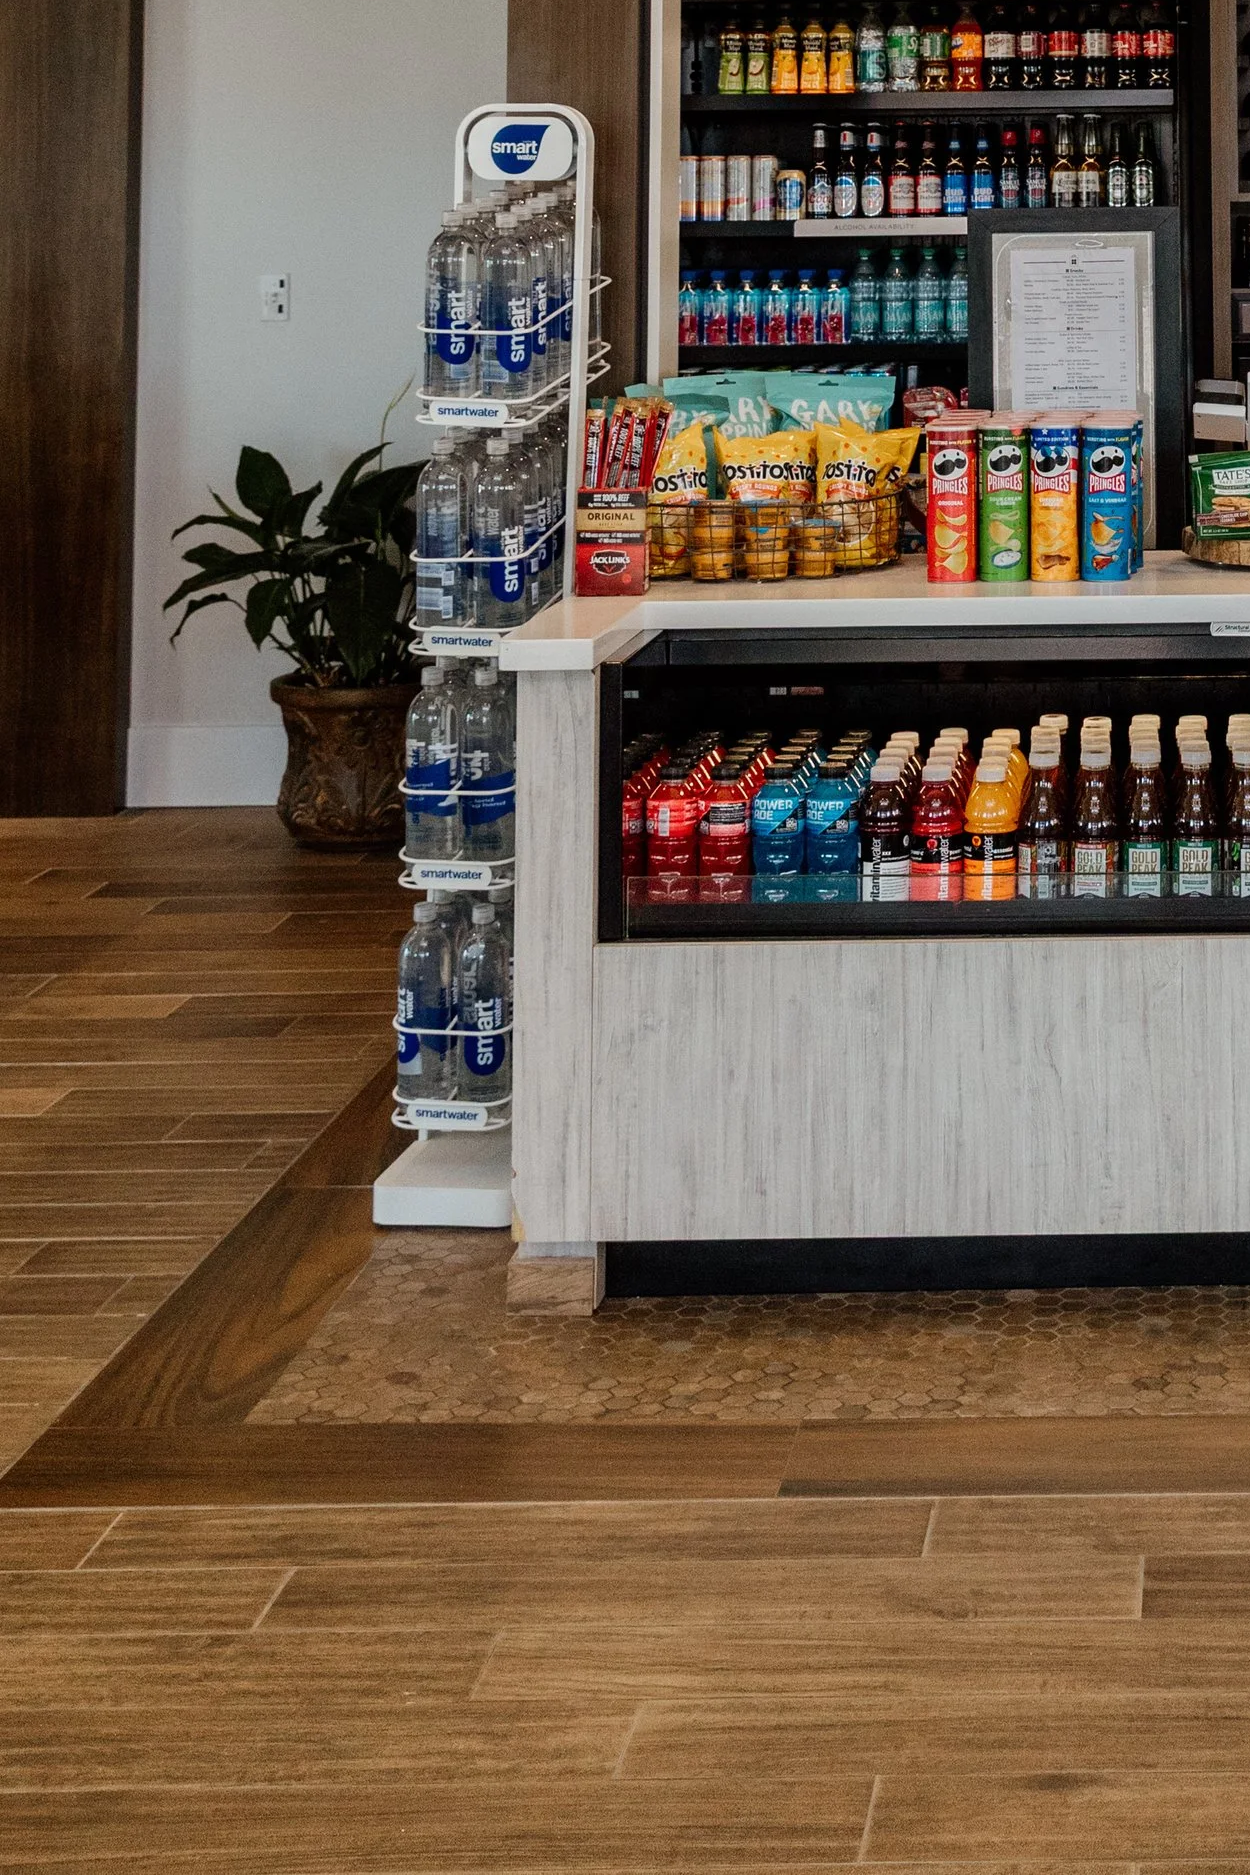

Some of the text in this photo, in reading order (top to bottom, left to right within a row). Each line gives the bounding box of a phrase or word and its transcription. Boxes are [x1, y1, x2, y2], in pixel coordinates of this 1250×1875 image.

[492, 140, 538, 154] smart
[943, 196, 967, 204] LIGHT
[971, 194, 996, 202] LIGHT
[448, 290, 466, 355] smart
[509, 297, 526, 363] smart
[437, 405, 499, 417] smartwater
[790, 399, 873, 424] GARY
[932, 478, 968, 495] PRINGLES
[987, 473, 1023, 492] PRINGLES
[1034, 475, 1070, 492] PRINGLES
[1089, 474, 1125, 493] PRINGLES
[602, 494, 617, 502] 100%
[587, 512, 636, 521] ORIGINAL
[501, 526, 519, 593] smart
[431, 636, 493, 648] smartwater
[754, 799, 794, 811] POWER
[806, 799, 844, 811] POWER
[755, 811, 774, 821] ADE
[806, 811, 824, 821] ADE
[1077, 850, 1103, 863] GOLD
[1131, 850, 1157, 863] GOLD
[1182, 849, 1208, 862] GOLD
[420, 868, 484, 880] smartwater
[1077, 863, 1103, 876] PEAK
[1131, 863, 1157, 876] PEAK
[1182, 862, 1208, 876] PEAK
[475, 999, 494, 1066] smart
[415, 1108, 479, 1121] smartwater
